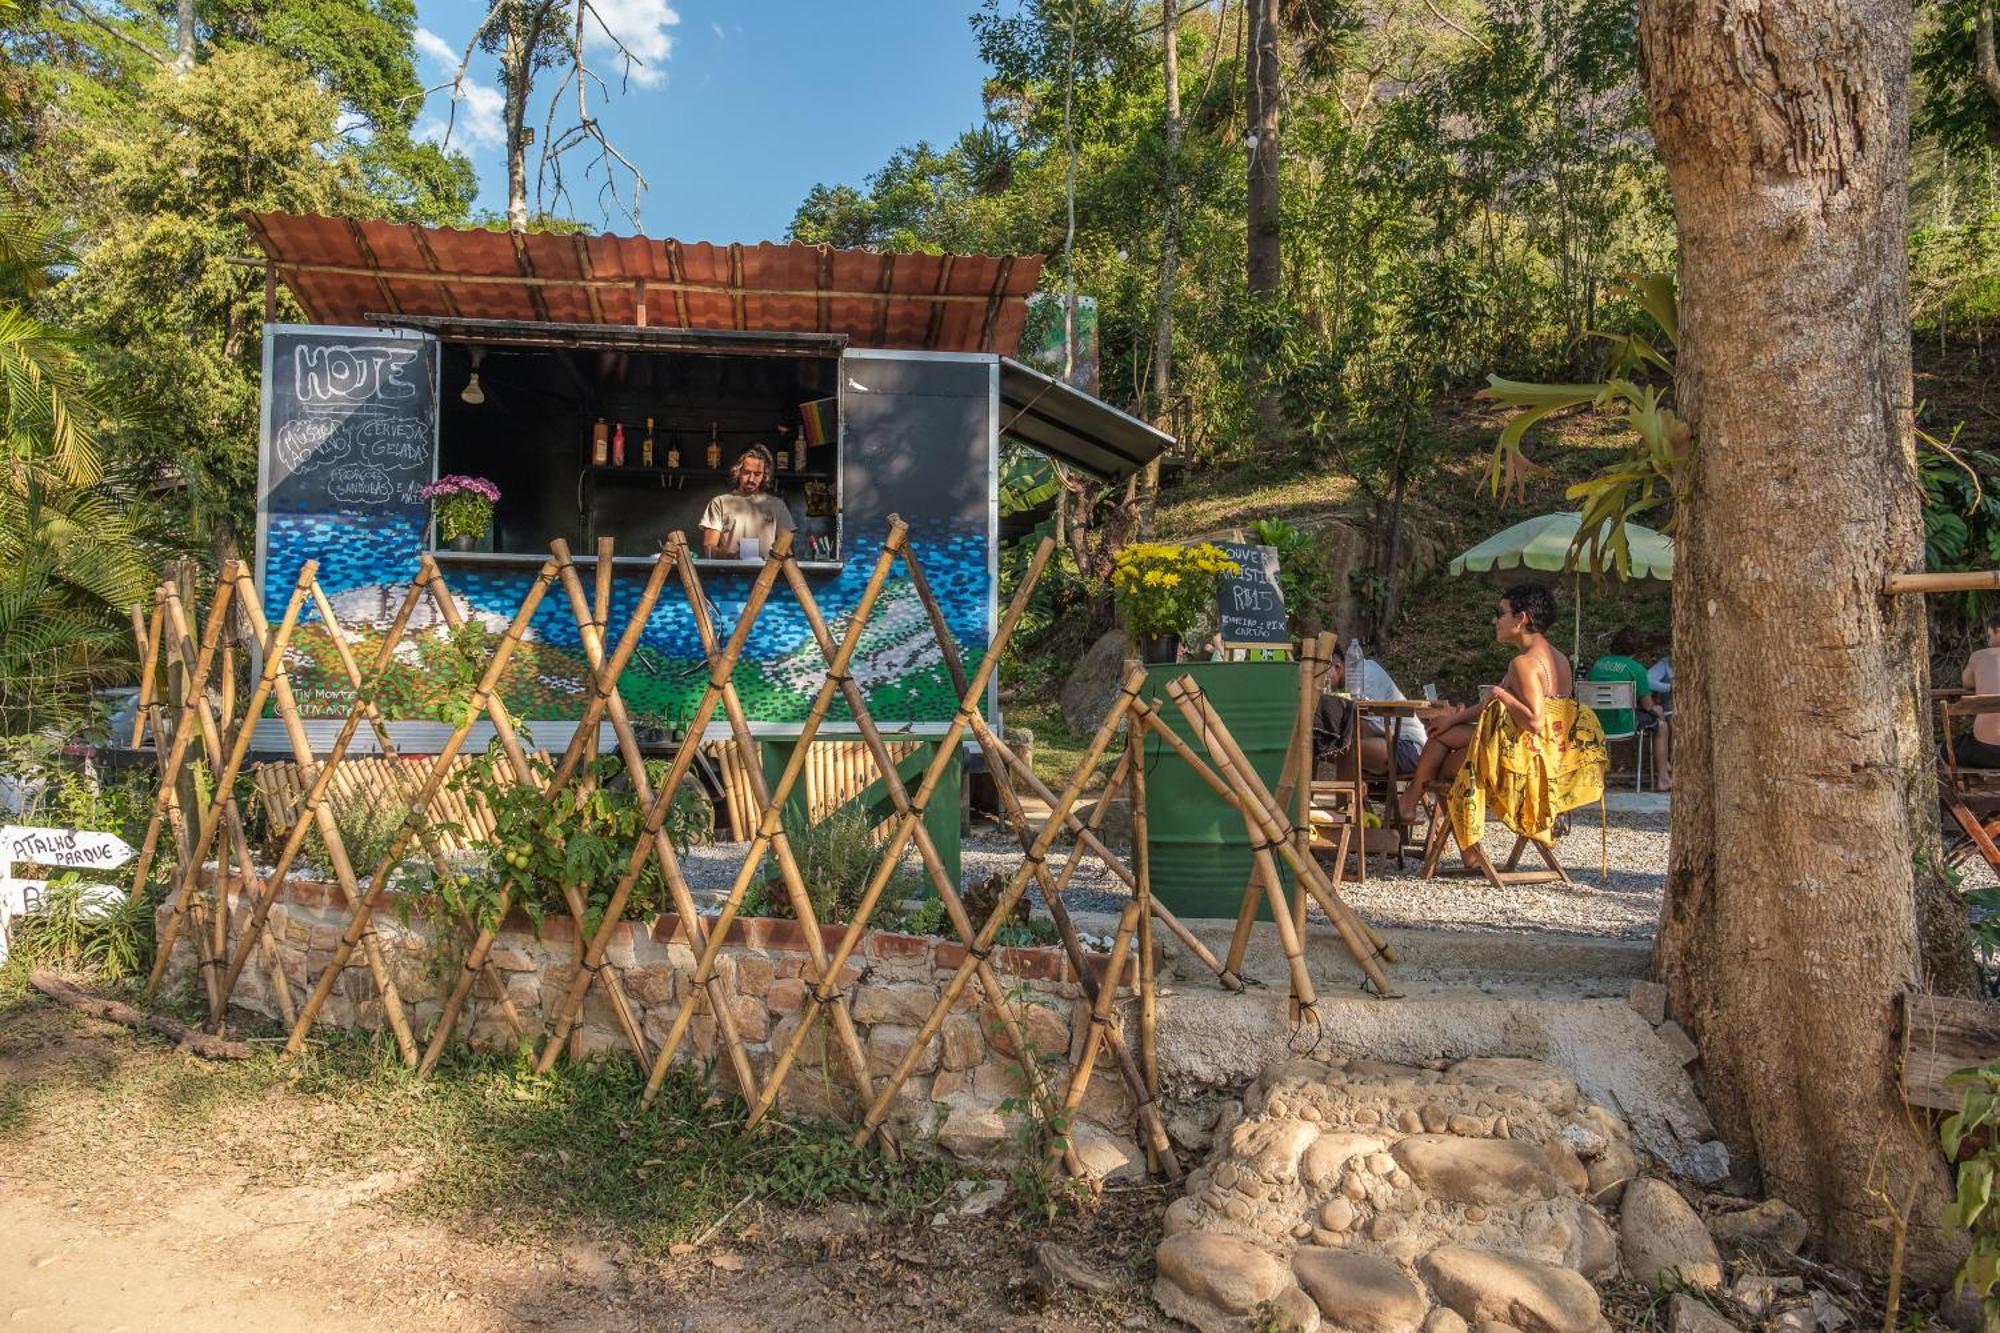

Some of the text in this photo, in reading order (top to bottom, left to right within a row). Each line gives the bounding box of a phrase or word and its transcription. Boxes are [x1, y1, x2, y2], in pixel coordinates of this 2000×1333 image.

[294, 345, 419, 401] HOJE
[363, 420, 424, 441] CERVEJA
[292, 448, 312, 468] AO
[372, 439, 422, 461] GELADA
[1266, 620, 1285, 631] PIX
[12, 832, 77, 860] ATALHO
[55, 843, 113, 866] PARQUE
